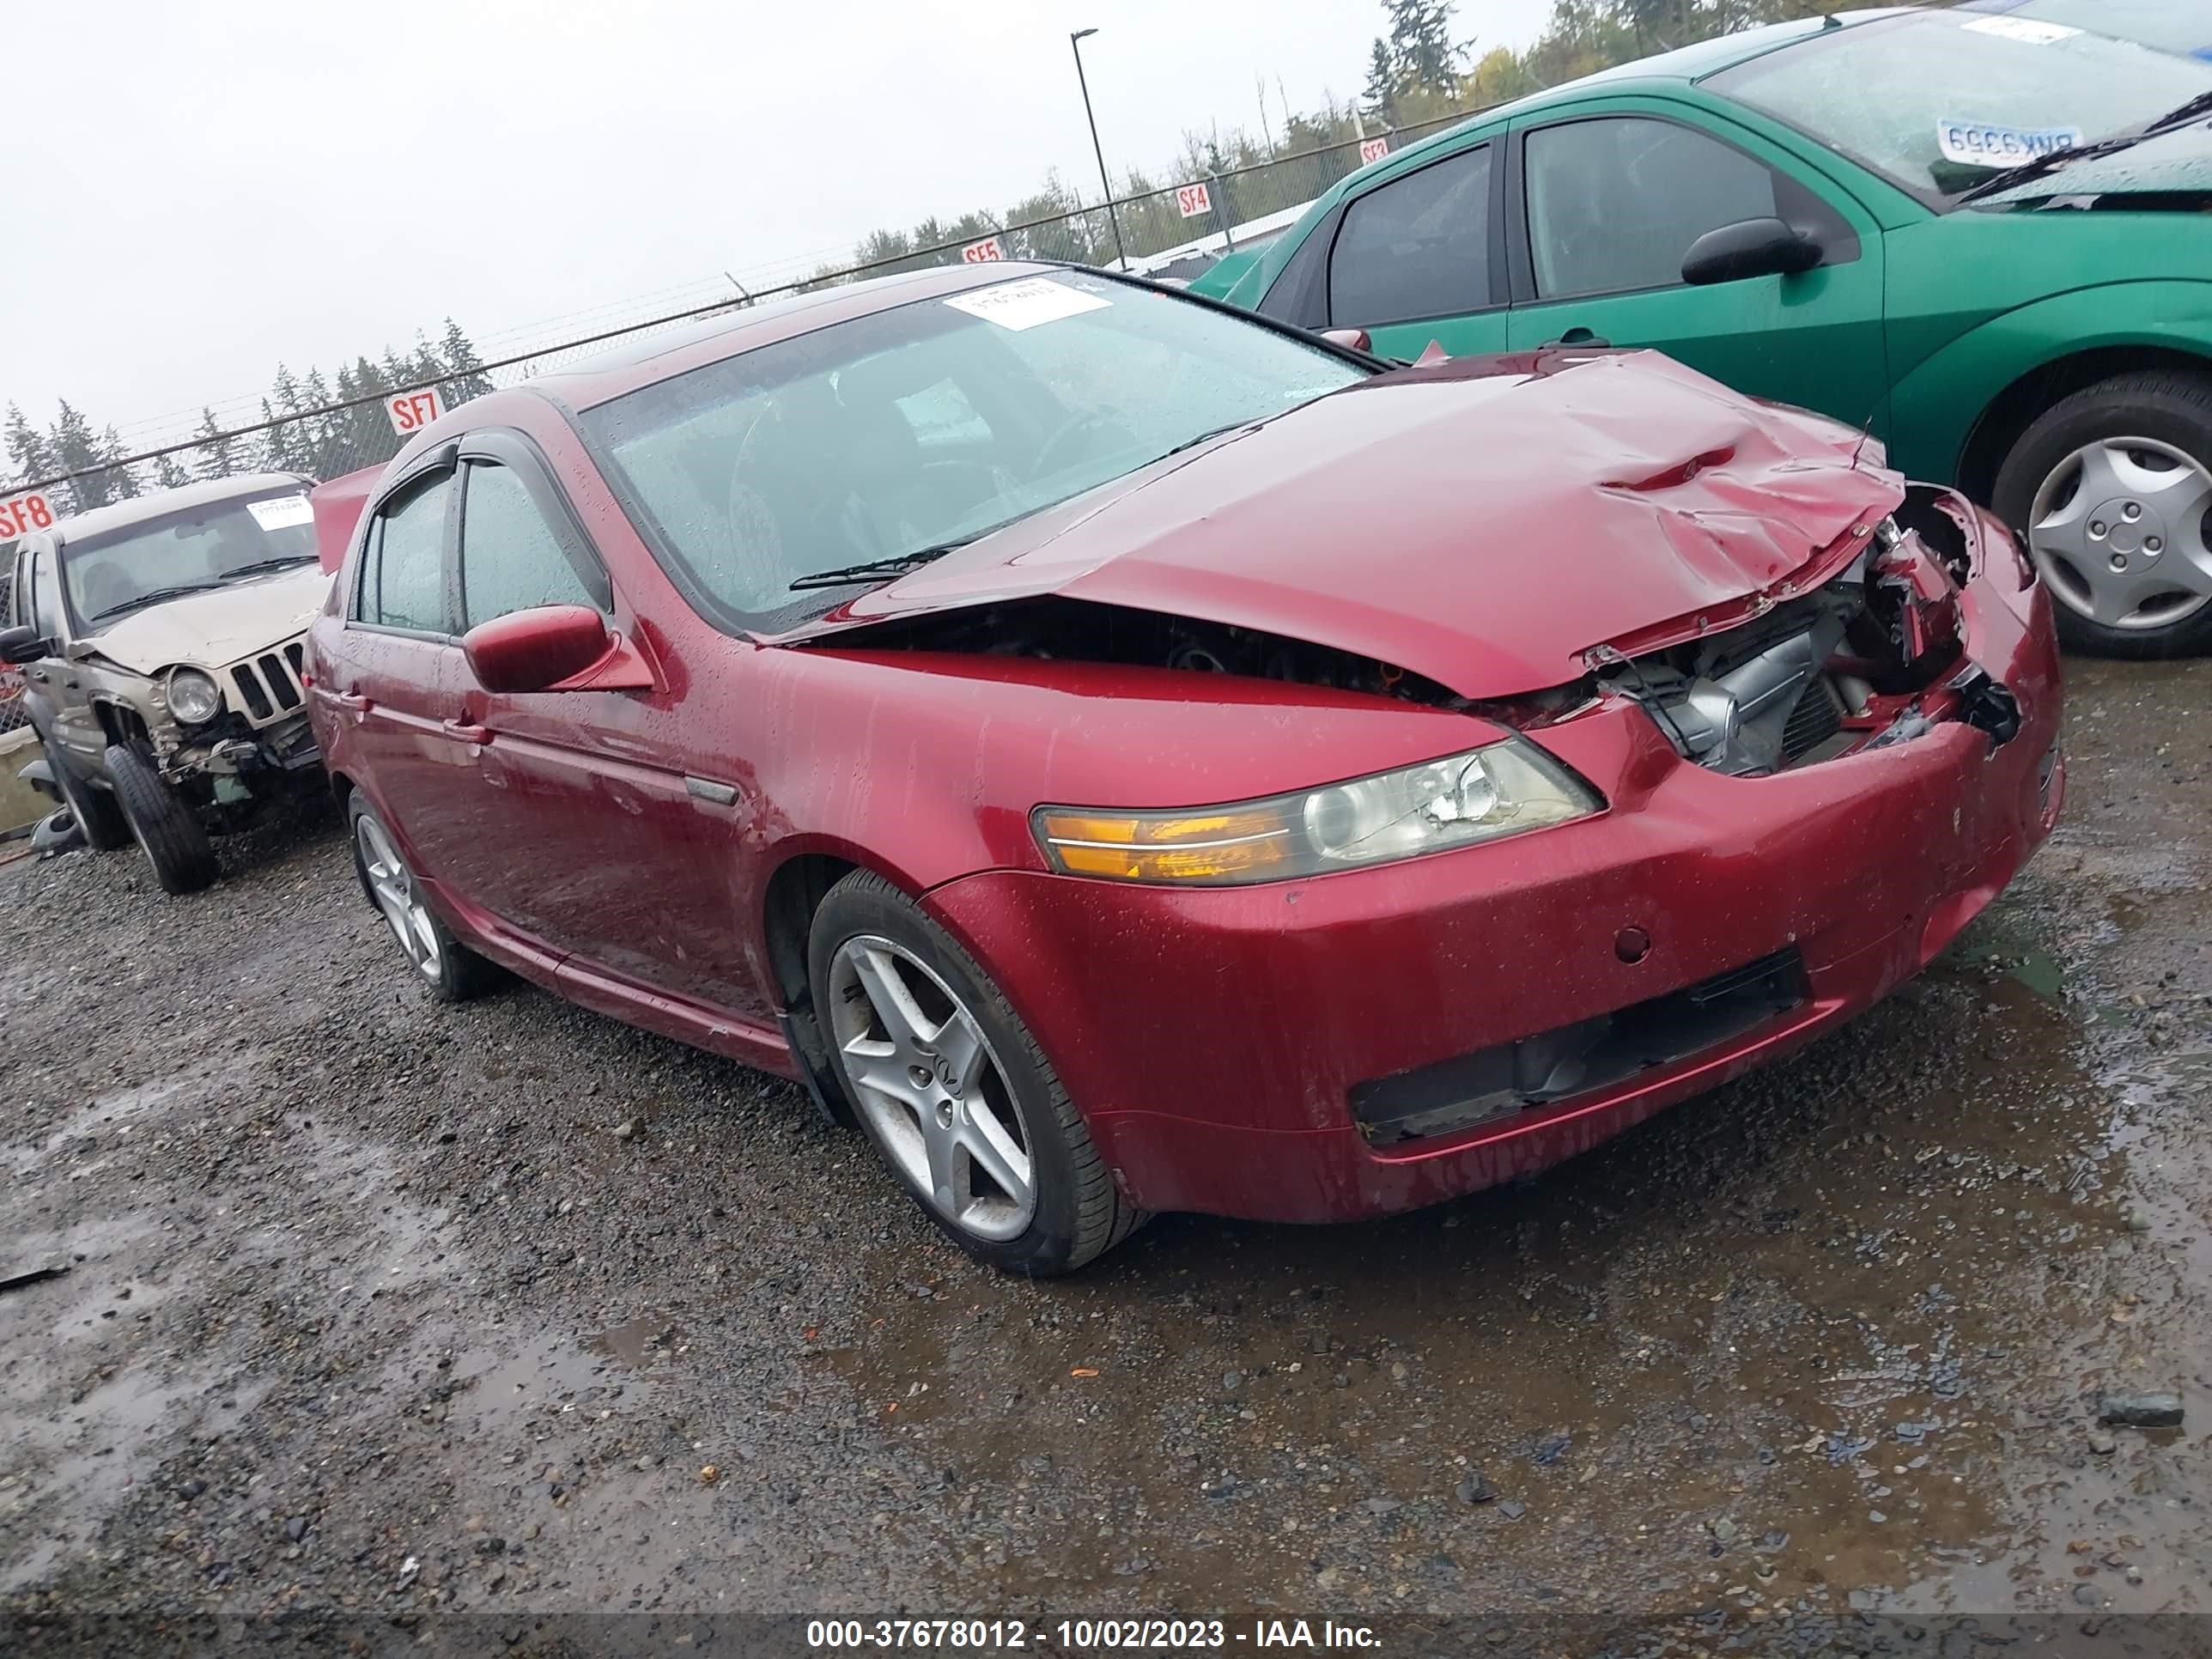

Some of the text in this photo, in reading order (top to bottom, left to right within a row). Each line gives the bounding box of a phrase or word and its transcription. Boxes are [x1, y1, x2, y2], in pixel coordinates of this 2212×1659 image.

[1180, 186, 1206, 213] SF4
[392, 392, 437, 428] SF7
[0, 495, 52, 538] SF8
